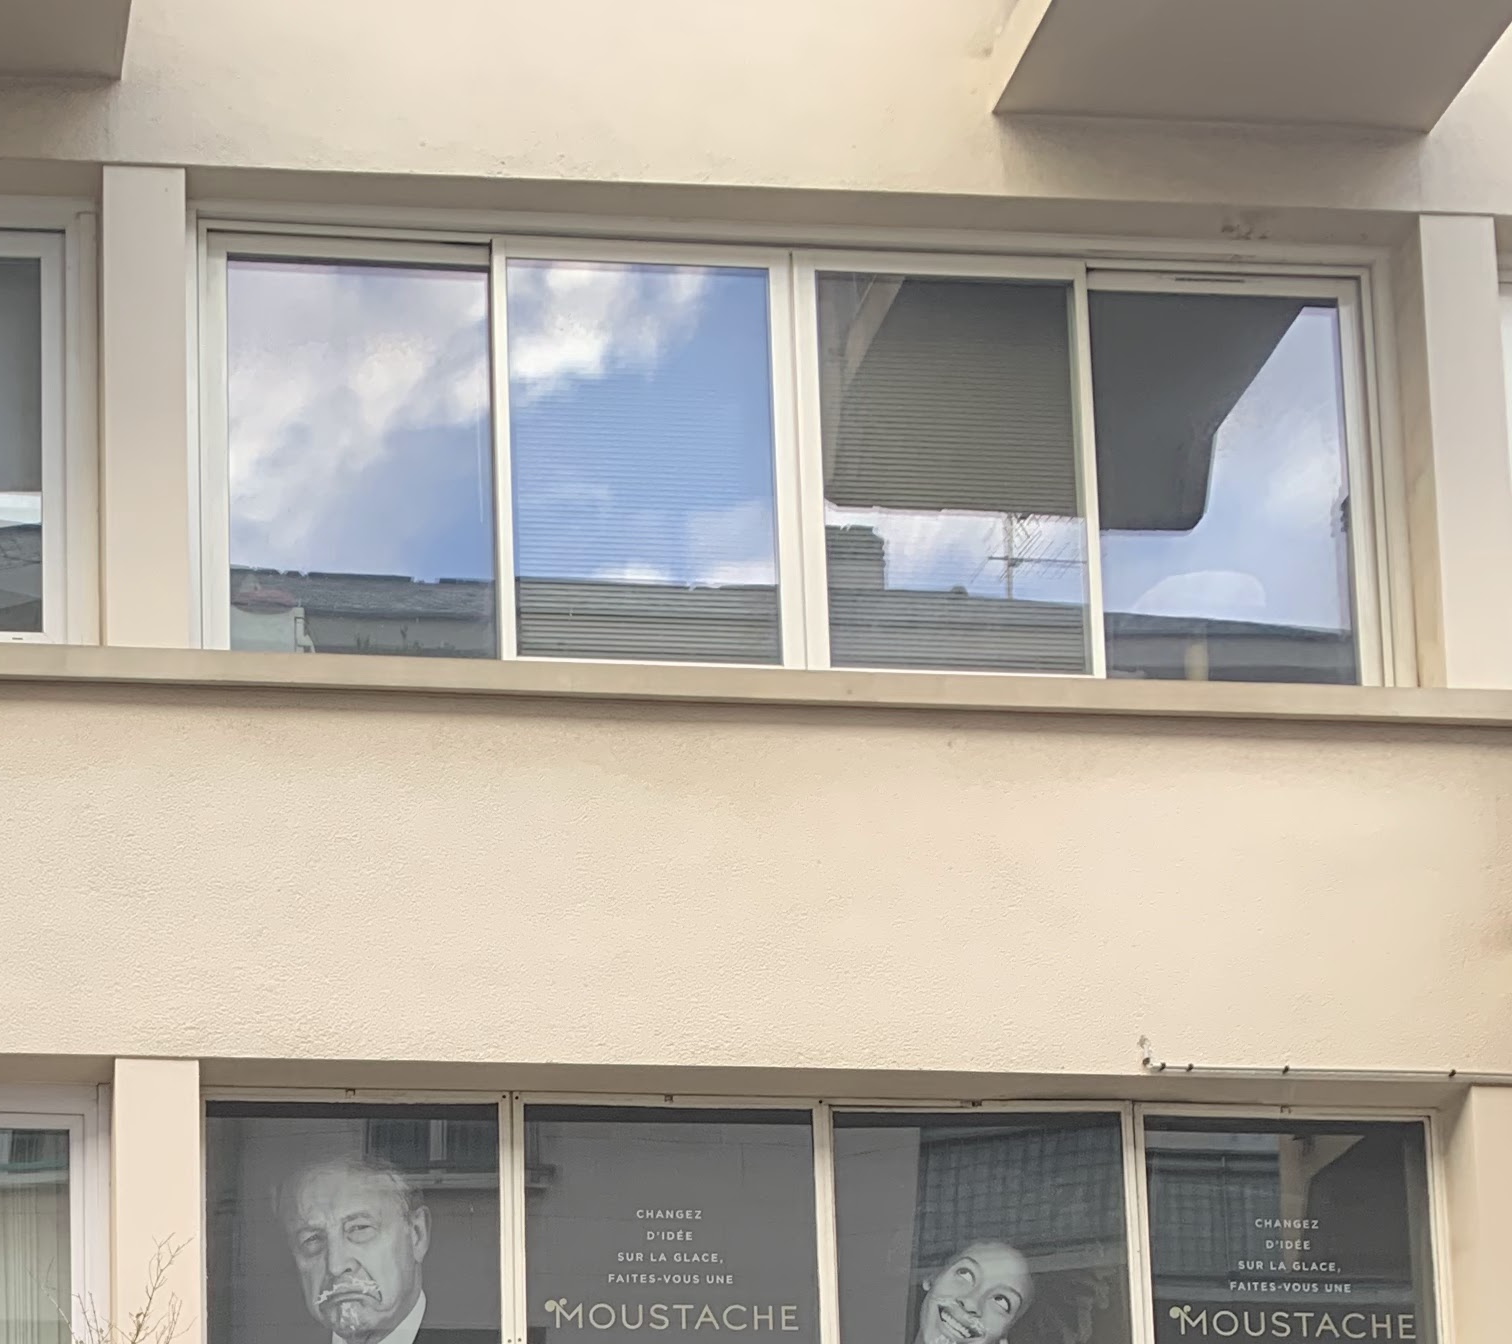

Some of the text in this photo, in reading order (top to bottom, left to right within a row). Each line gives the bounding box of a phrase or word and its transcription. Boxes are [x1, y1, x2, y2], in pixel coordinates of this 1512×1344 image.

[636, 1209, 702, 1220] CHANGEZ
[1255, 1219, 1319, 1230] CHANGEZ
[646, 1229, 693, 1241] D'IDÉE
[1265, 1239, 1311, 1250] D'IDÉE
[617, 1252, 724, 1264] SUR LA GLACE,
[1238, 1261, 1341, 1273] SUR LA GLACE,
[608, 1273, 733, 1285] FAITES-VOUS UNE
[1229, 1281, 1351, 1293] FAITES-VOUS UNE
[544, 1298, 799, 1331] MOUSTACHE
[1169, 1305, 1416, 1339] MOUSTACHE
